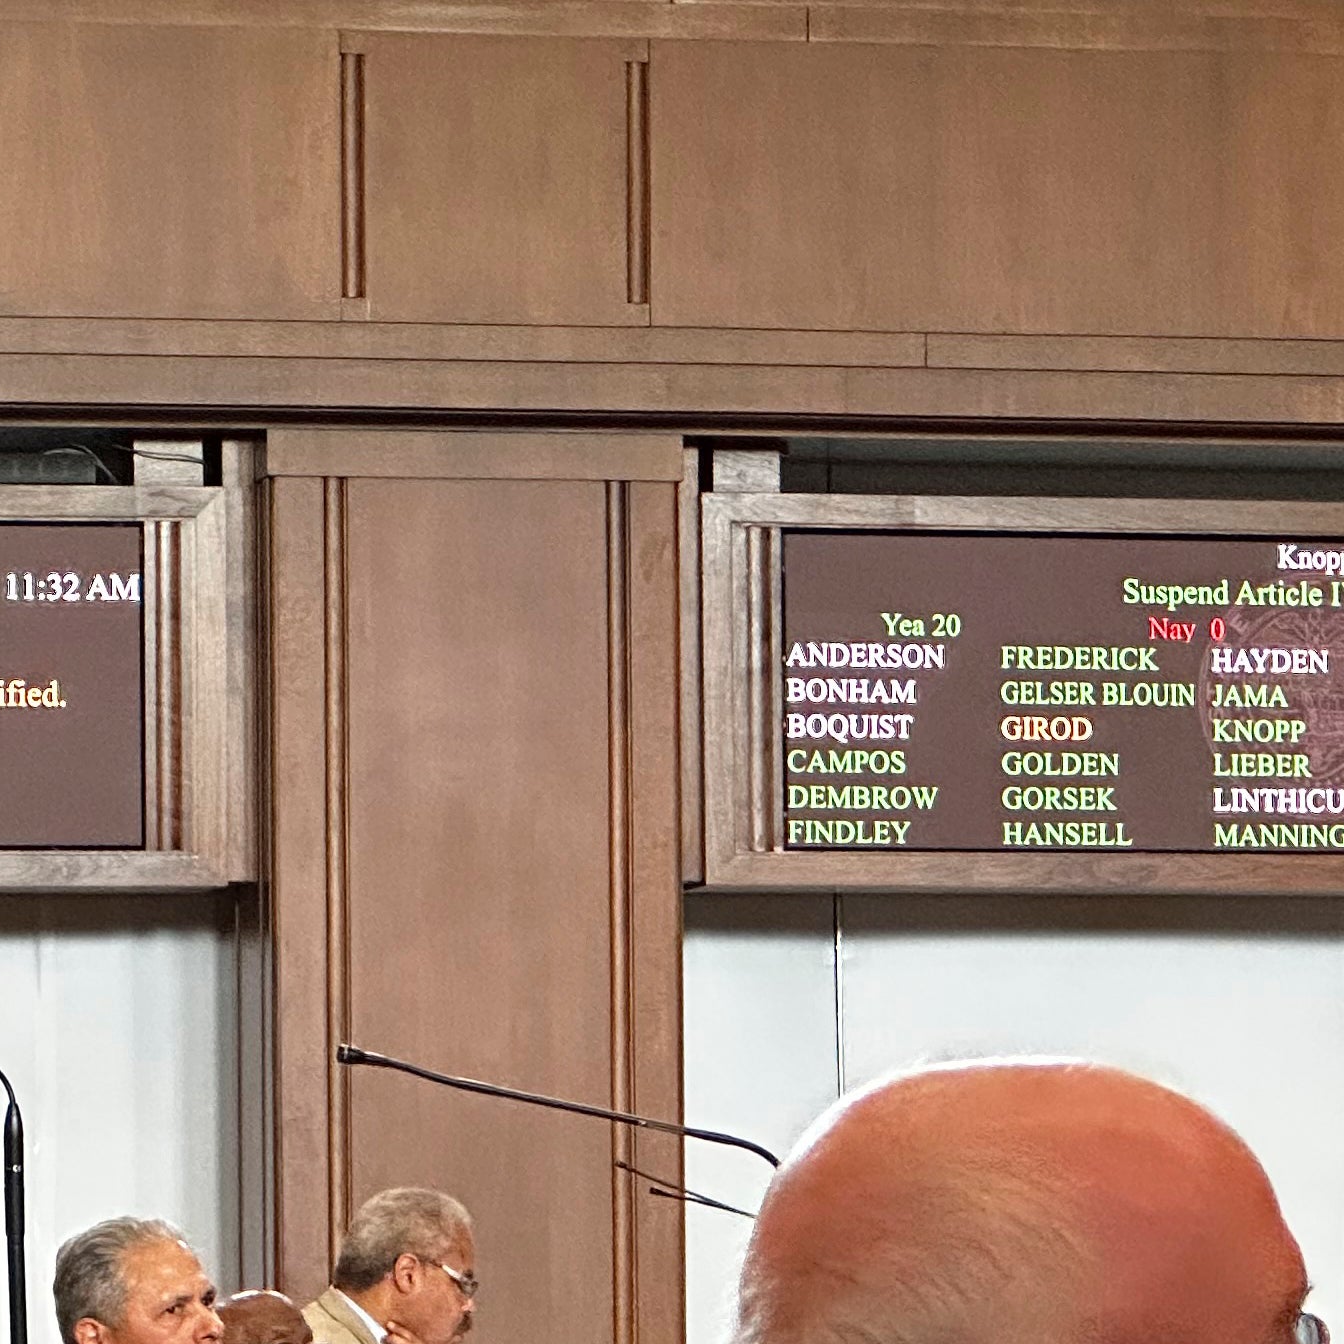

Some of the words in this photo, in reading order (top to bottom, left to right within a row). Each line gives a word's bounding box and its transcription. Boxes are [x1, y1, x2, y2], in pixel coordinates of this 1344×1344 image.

[6, 571, 81, 602] 11:32
[85, 571, 141, 602] AM
[1123, 578, 1229, 613] Suspend
[1235, 580, 1323, 608] Article
[881, 613, 926, 637] Yea
[931, 613, 961, 638] 20
[1148, 616, 1196, 644] Nay
[1209, 616, 1226, 642] 0
[786, 642, 946, 670] ANDERSON
[1000, 645, 1160, 671] FREDERICK
[1210, 646, 1330, 674] HAYDEN
[786, 677, 917, 705] BONHAM
[1000, 680, 1097, 706] GELSER
[1101, 681, 1196, 707] BLOUIN
[1210, 682, 1290, 708] JAMA
[786, 712, 915, 744] BOQUIST
[1000, 715, 1094, 742] GIROD
[1211, 718, 1307, 743] KNOPP
[786, 749, 907, 775] CAMPOS
[1001, 751, 1120, 777] GOLDEN
[1212, 752, 1313, 778] LIEBER
[787, 785, 939, 810] DEMBROW
[1001, 786, 1119, 812] GORSEK
[787, 820, 911, 845] FINDLEY
[1002, 821, 1134, 847] HANSELL
